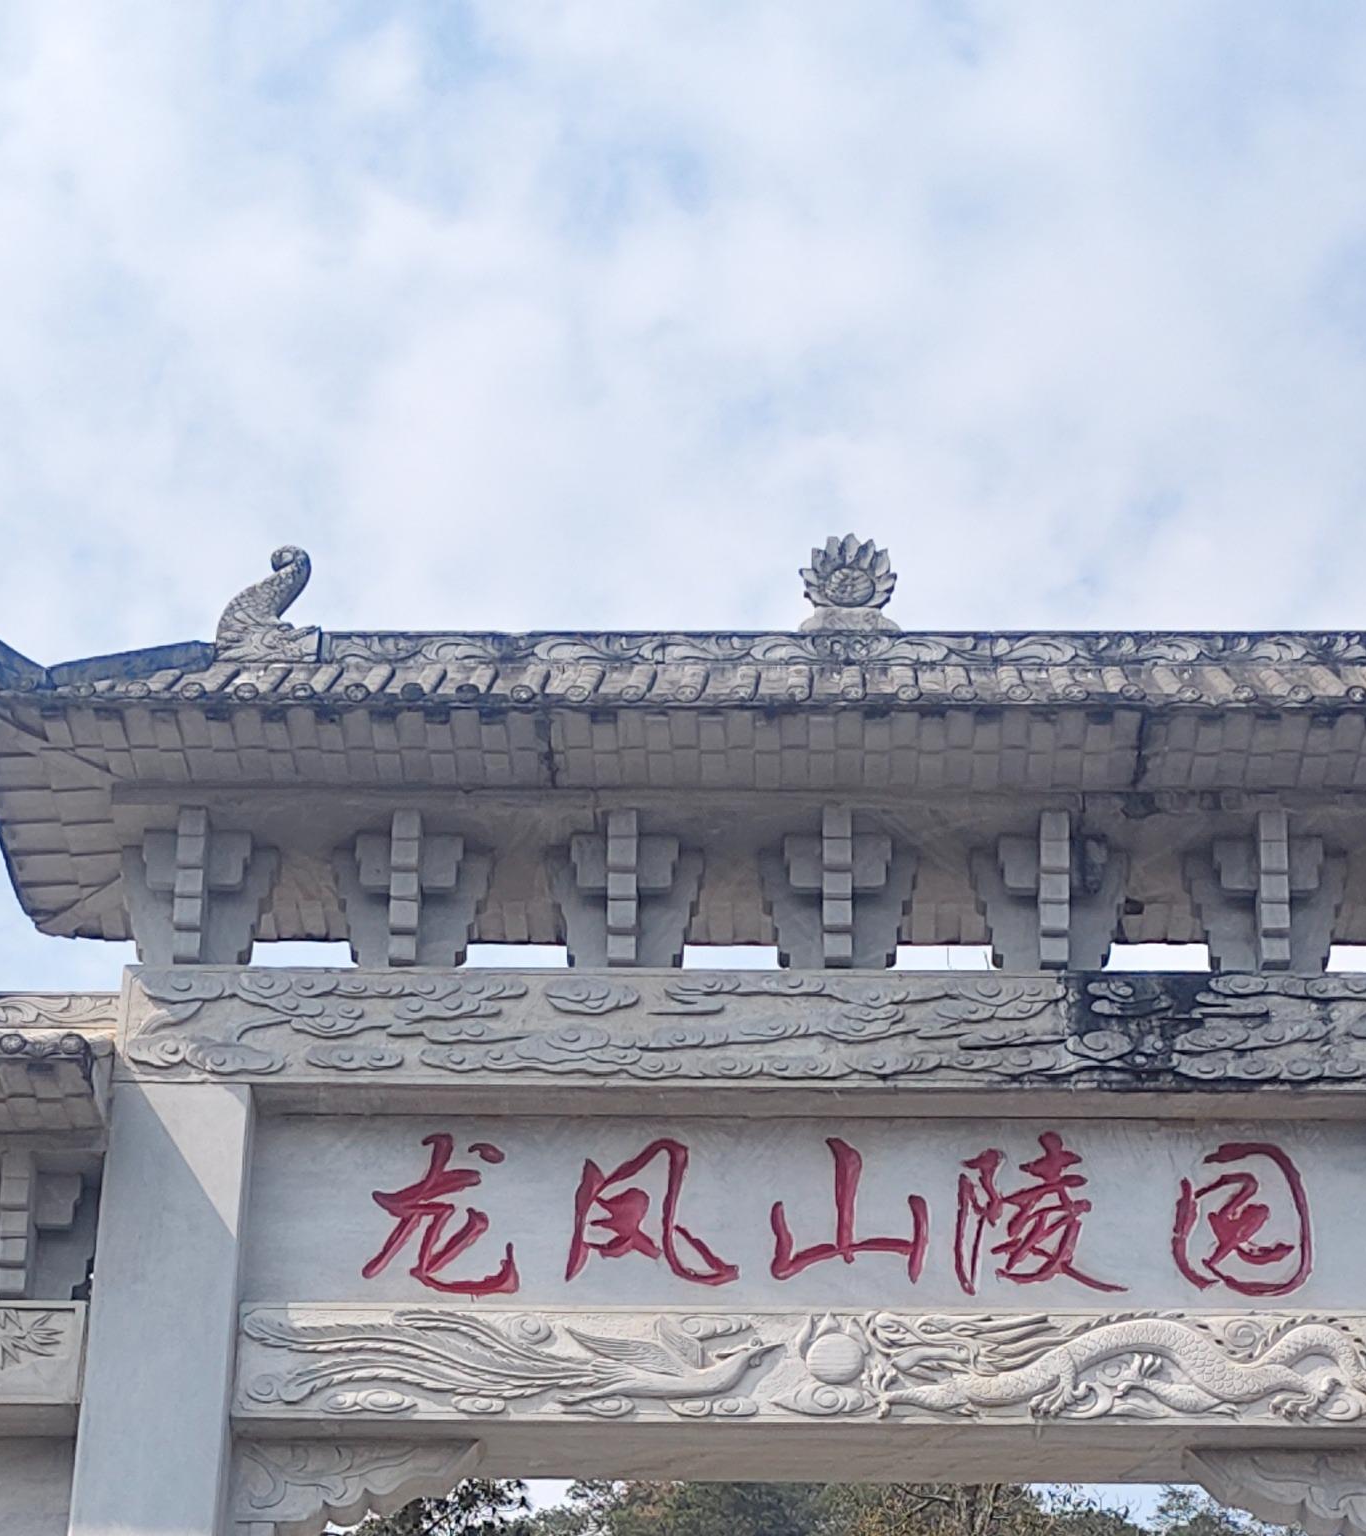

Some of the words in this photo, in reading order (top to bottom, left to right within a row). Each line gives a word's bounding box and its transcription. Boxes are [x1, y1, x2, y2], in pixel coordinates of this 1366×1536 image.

[361, 1131, 1315, 1297] 龙凤山陵园
